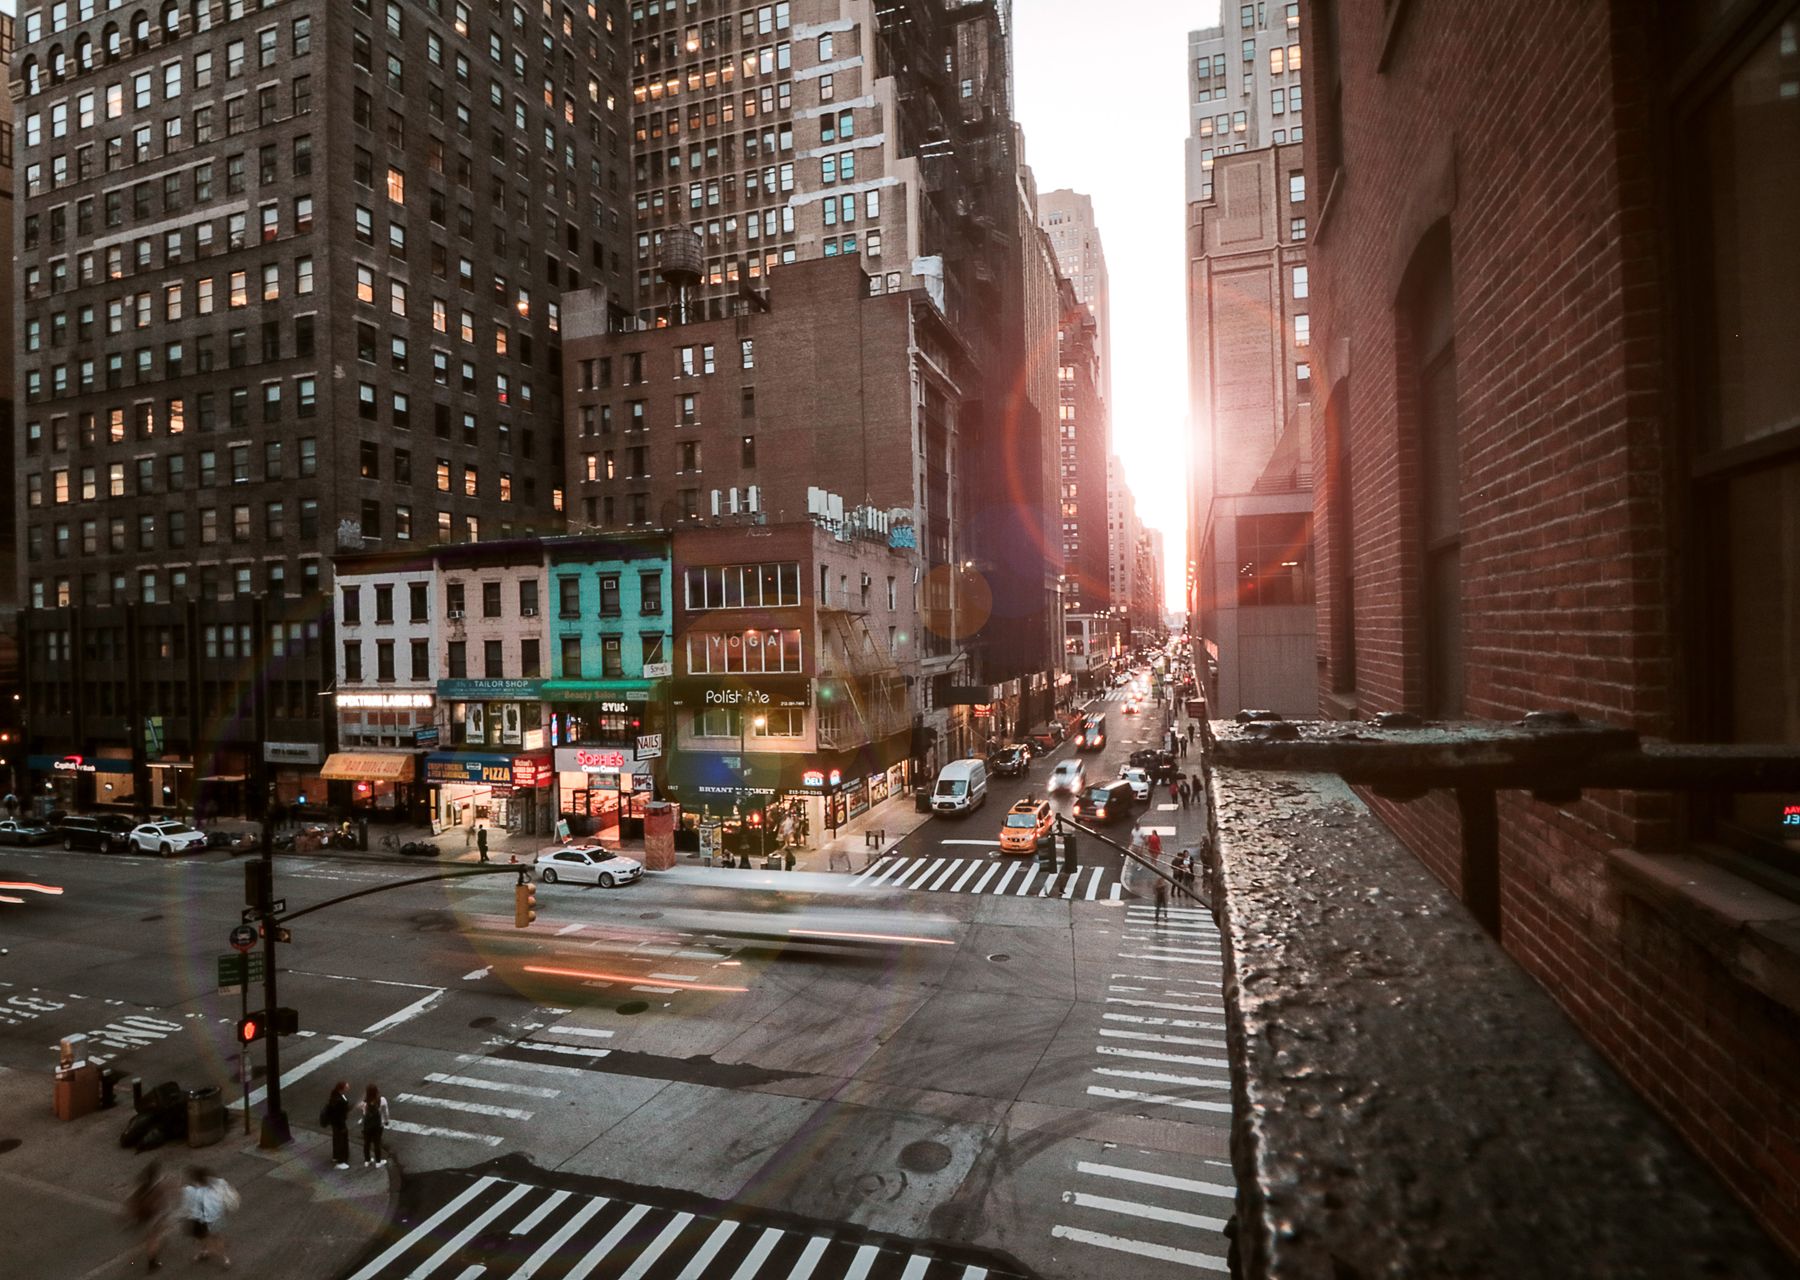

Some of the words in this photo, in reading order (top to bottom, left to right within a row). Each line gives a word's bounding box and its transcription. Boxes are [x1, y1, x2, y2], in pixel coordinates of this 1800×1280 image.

[712, 635, 777, 647] YOGA
[473, 680, 503, 688] TAILOR
[505, 680, 529, 688] SHOP
[637, 735, 659, 749] NAILS
[576, 750, 625, 767] SOPHIE'S
[483, 767, 511, 781] PIZZA
[804, 778, 823, 786] DELI
[699, 786, 733, 794] BRYANT
